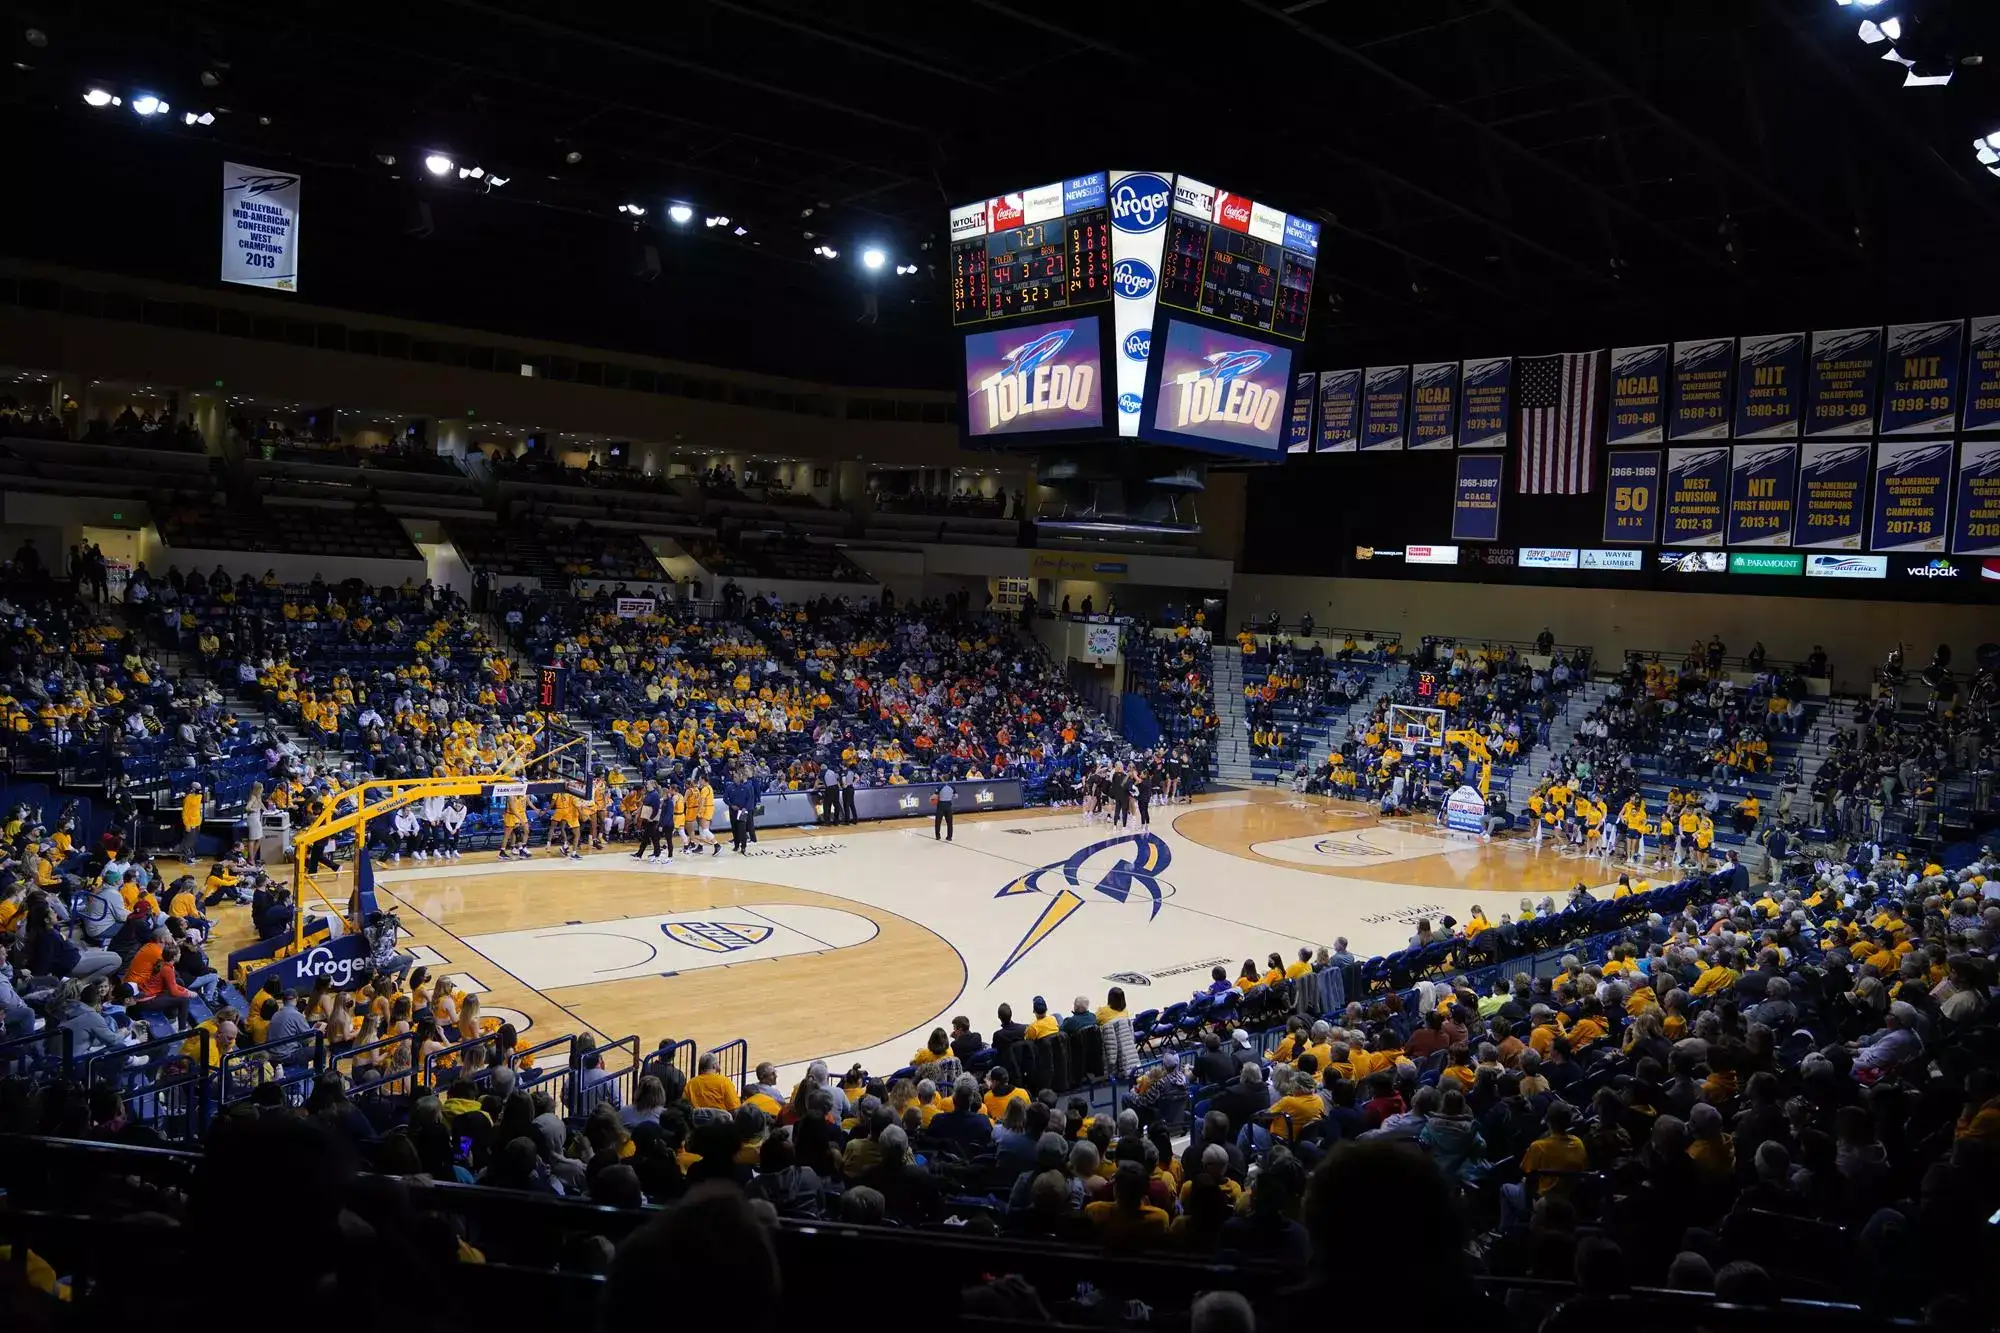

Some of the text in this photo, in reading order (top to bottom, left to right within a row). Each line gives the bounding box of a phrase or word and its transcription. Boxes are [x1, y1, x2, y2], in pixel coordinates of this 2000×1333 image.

[1073, 175, 1098, 188] BLADE
[241, 201, 283, 216] VOLLEYBALL
[1111, 186, 1170, 226] Kroger
[233, 209, 290, 227] MID-AMERICAN
[953, 217, 973, 228] WTOL
[237, 220, 285, 236] CONFERENCE
[1293, 218, 1313, 233] BLADE
[250, 232, 272, 244] WEST
[1016, 226, 1045, 247] 7:27
[239, 240, 283, 254] CHAMPIONS
[246, 252, 275, 269] 2013
[994, 253, 1014, 265] TOLEDO
[1214, 251, 1233, 264] TOLEDO
[1023, 263, 1030, 278] 3
[1046, 256, 1064, 276] 27
[994, 267, 1011, 283] 44
[1113, 264, 1153, 295] Kroger
[1044, 288, 1050, 299] 3
[1227, 287, 1242, 297] PLAYER
[996, 292, 1002, 308] 3
[1006, 296, 1012, 305] 4
[1020, 304, 1034, 313] MATCH
[1201, 305, 1214, 315] SCORE
[1229, 312, 1243, 322] MATCH
[1258, 320, 1271, 330] SCORE
[1127, 336, 1151, 357] Krog
[1817, 360, 1873, 371] MID-AMERICAN
[1904, 357, 1941, 378] NIT
[1678, 371, 1728, 381] MID-AMERICAN
[1754, 367, 1785, 386] NIT
[1820, 370, 1866, 380] CONFERENCE
[1617, 376, 1659, 396] NCAA
[1681, 381, 1722, 391] CONFERENCE
[1832, 380, 1853, 389] WEST
[1912, 378, 1948, 390] ROUND
[981, 364, 1093, 429] TOLEDO
[1416, 387, 1450, 403] NCAA
[1681, 392, 1721, 401] CHAMPIONS
[1749, 388, 1776, 397] SWEET
[1820, 390, 1864, 400] CHAMPIONS
[1120, 395, 1142, 412] Kroger
[1177, 370, 1280, 431] TOLEDO
[1890, 396, 1949, 412] 1998-99
[1746, 404, 1790, 417] 1980-81
[1816, 404, 1866, 417] 1998-99
[1611, 467, 1656, 476] 1966-1969
[1460, 479, 1498, 488] 1965-1987
[1683, 479, 1710, 490] WEST
[1747, 478, 1776, 497] NIT
[1807, 481, 1857, 491] MID-AMERICAN
[1885, 477, 1941, 487] MID-AMERICAN
[1811, 490, 1853, 499] CONFERENCE
[1889, 486, 1935, 495] CONFERENCE
[1615, 486, 1649, 512] 50
[1674, 491, 1717, 503] DIVISION
[1899, 498, 1922, 507] WEST
[1670, 505, 1720, 515] CO-CHAMPIONS
[1733, 500, 1790, 511] FIRST ROUND
[1808, 500, 1853, 510] CHAMPIONS
[1886, 507, 1934, 517] CHAMPIONS
[1675, 518, 1713, 530] 2012-13
[1740, 516, 1780, 528] 2013-14
[1808, 514, 1851, 527] 2013-14
[1887, 521, 1931, 534] 2017-18
[1968, 523, 2000, 536] 2018
[1527, 549, 1545, 559] dave
[1549, 550, 1571, 559] white
[1747, 559, 1798, 568] PARAMOUNT
[1907, 565, 1958, 579] valpak
[620, 601, 652, 611] ESPN
[1420, 674, 1435, 683] 7:27
[540, 684, 553, 705] 30
[1418, 682, 1431, 695] 30
[377, 797, 408, 812] Schelde
[1151, 966, 1194, 978] MEDICAL
[1195, 958, 1234, 969] CENTER
